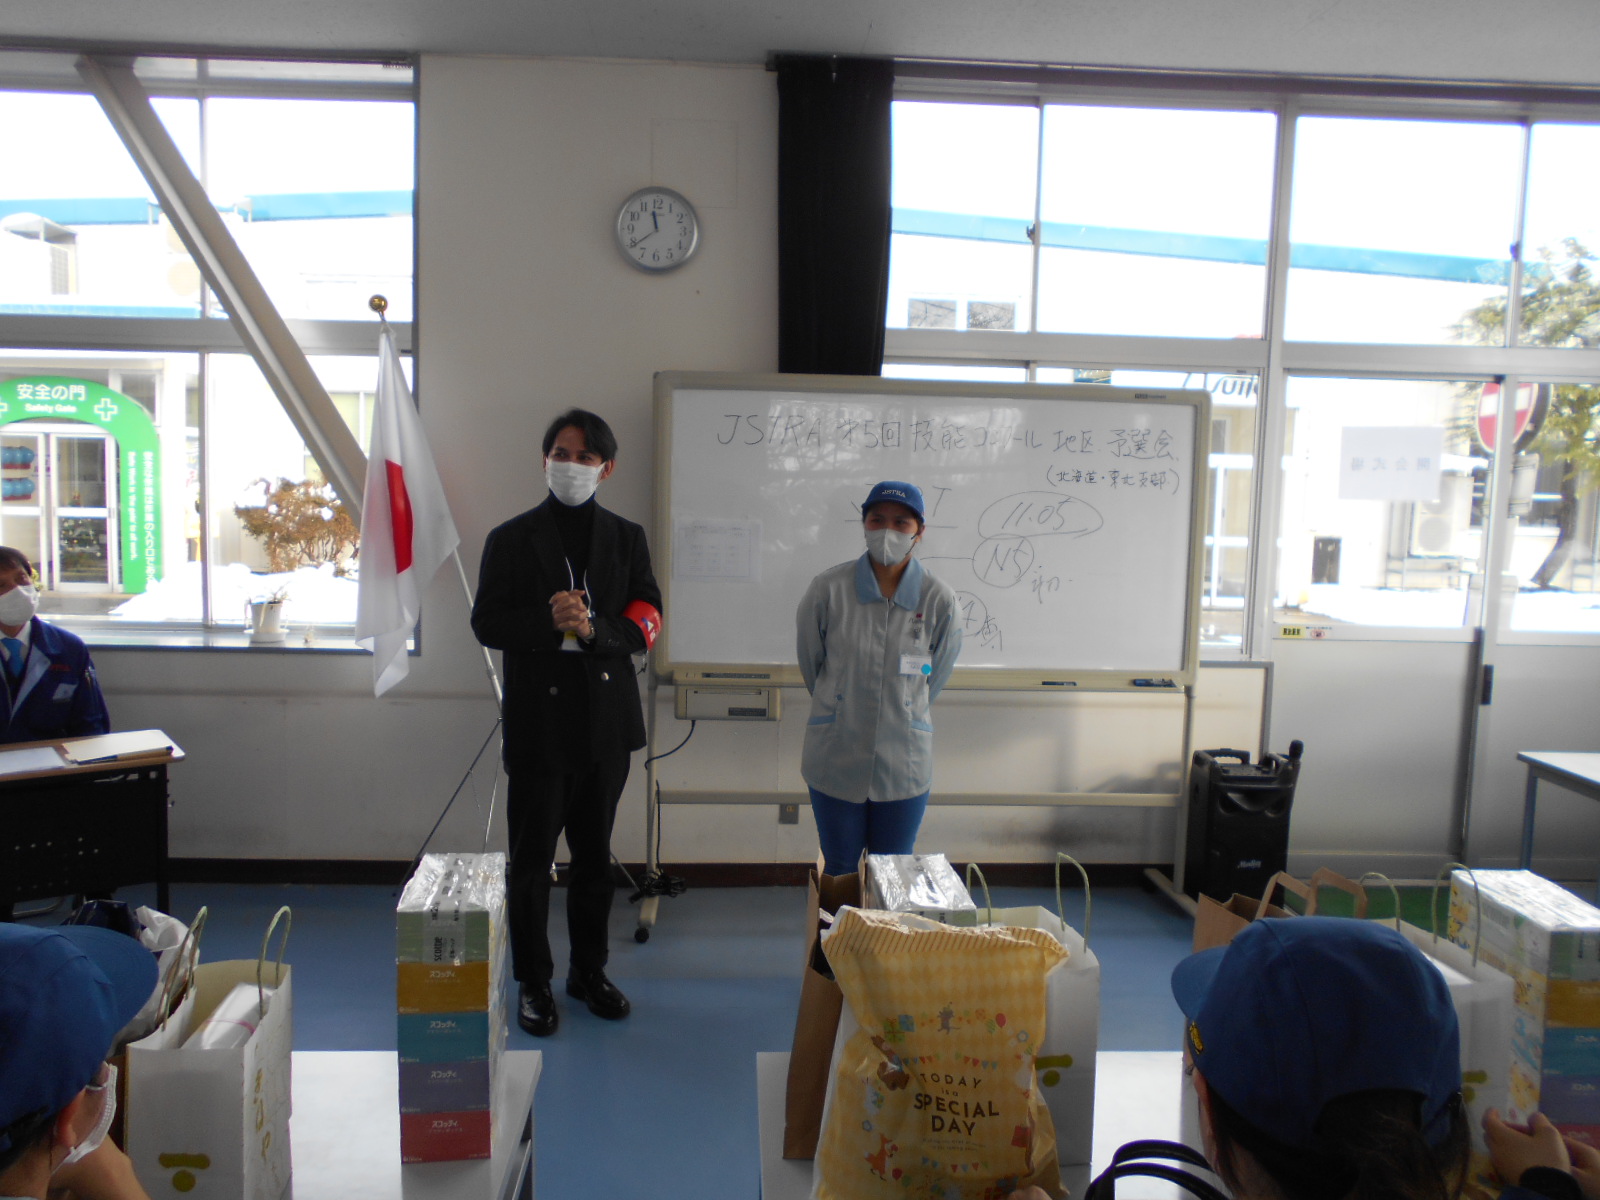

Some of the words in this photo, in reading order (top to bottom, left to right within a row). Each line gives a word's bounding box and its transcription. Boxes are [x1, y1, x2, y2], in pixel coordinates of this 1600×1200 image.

[640, 202, 647, 212] 11
[653, 198, 663, 209] 12
[630, 211, 640, 221] 10
[676, 213, 684, 224] 2
[627, 223, 634, 235] 9
[679, 226, 687, 237] 3
[629, 236, 637, 248] 8
[640, 247, 646, 258] 7
[652, 249, 660, 261] 6
[666, 248, 673, 259] 5
[16, 384, 86, 401] 安全の門
[24, 403, 53, 414] Safety
[54, 403, 77, 413] Gate
[717, 414, 822, 447] JSTRA
[1002, 497, 1076, 530] 11.05
[429, 1020, 457, 1029] スコッティ
[920, 1073, 981, 1088] TODAY
[914, 1093, 1000, 1118] SPECIAL
[931, 1115, 976, 1136] DAY
